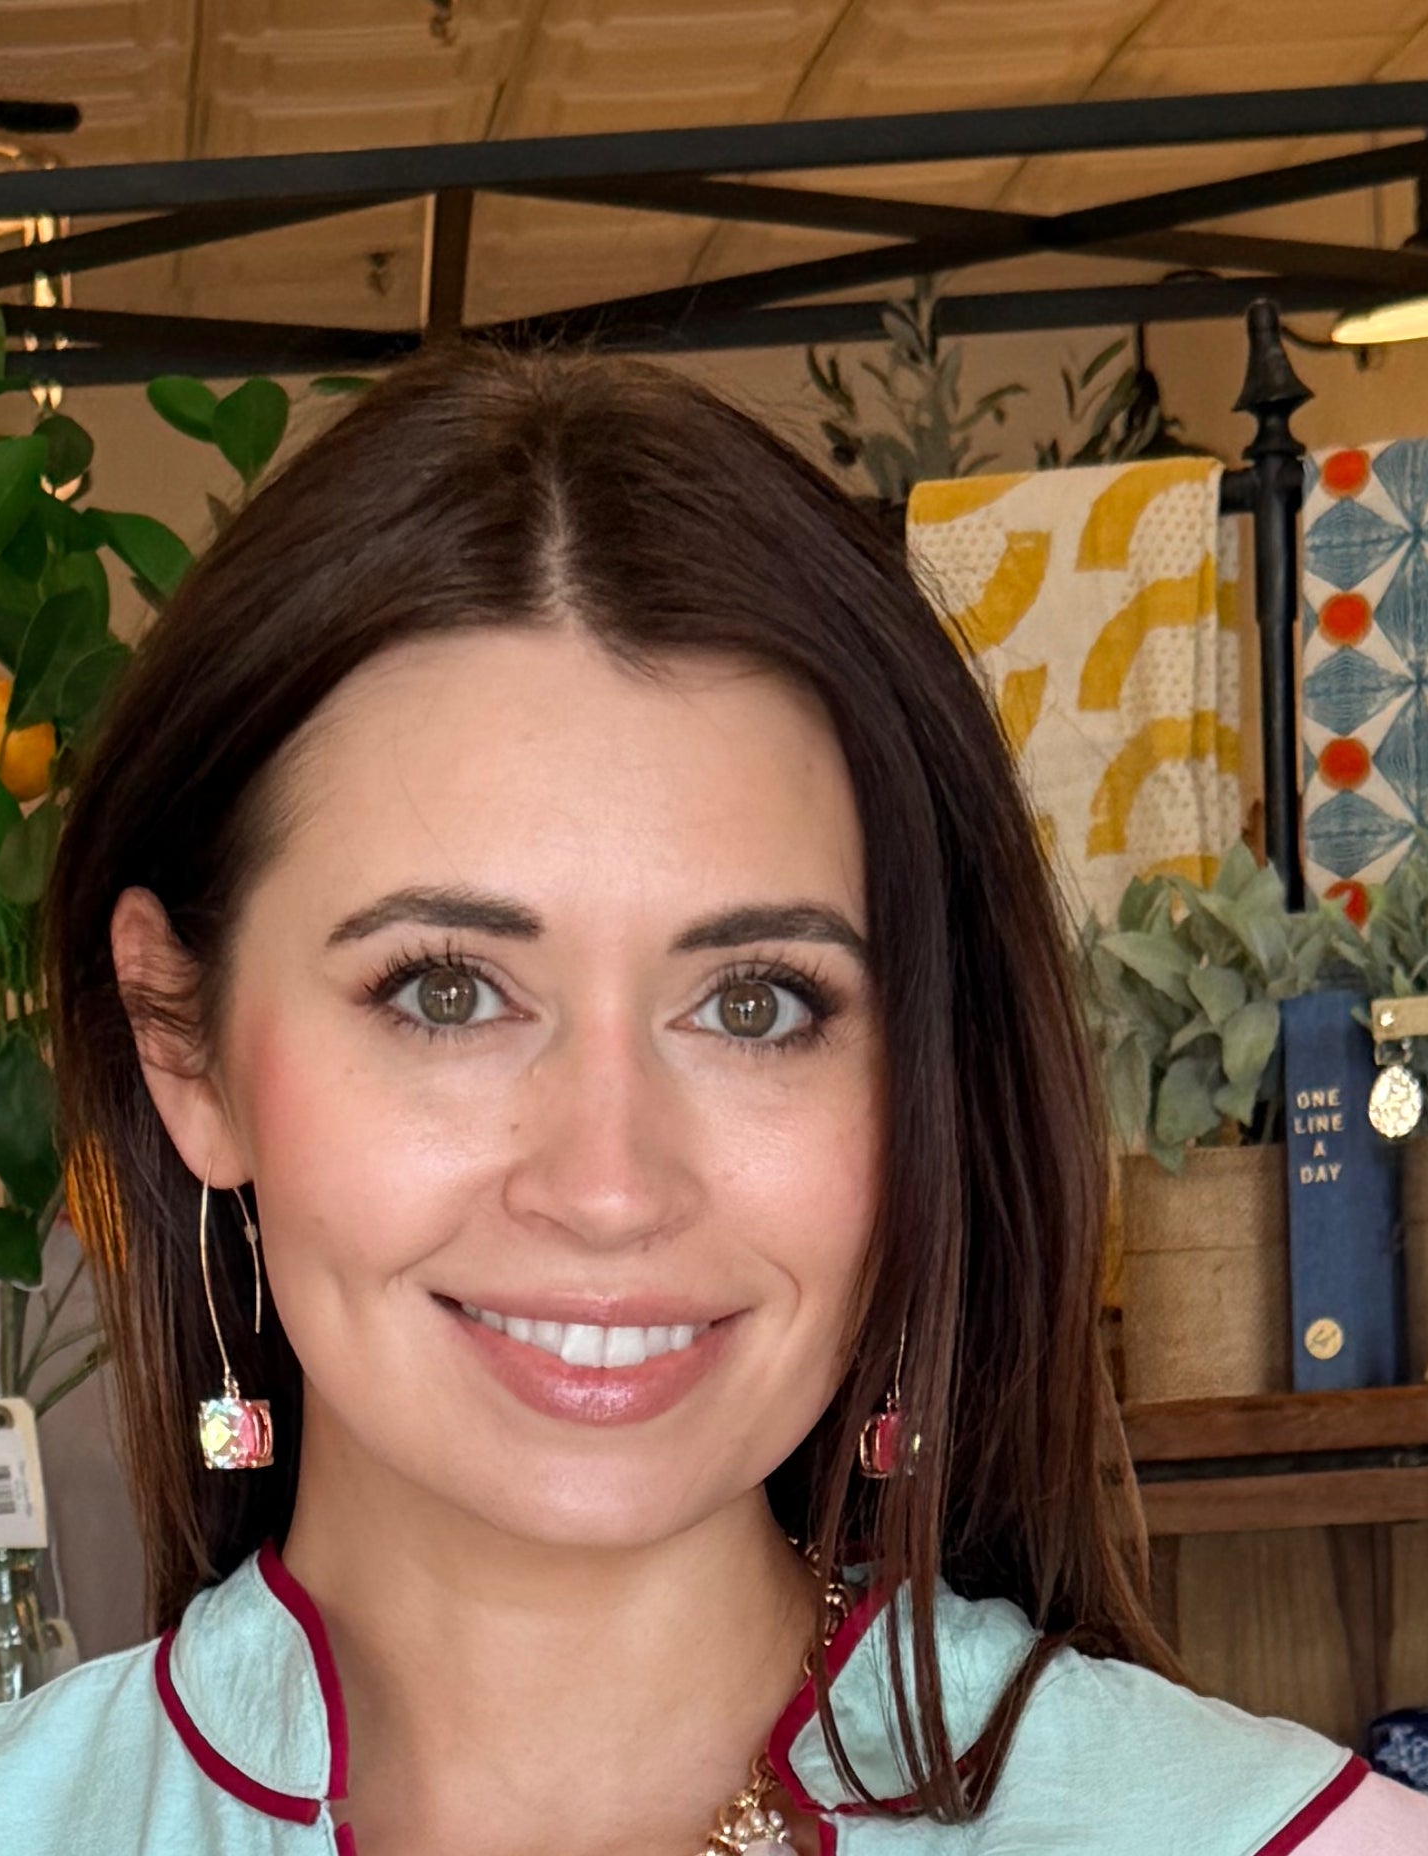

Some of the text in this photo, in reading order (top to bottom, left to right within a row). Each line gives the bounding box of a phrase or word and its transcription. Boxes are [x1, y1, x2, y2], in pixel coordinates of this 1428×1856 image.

[1296, 1088, 1341, 1110] ONE
[1294, 1113, 1344, 1135] LINE
[1313, 1140, 1327, 1157] A
[1299, 1163, 1342, 1185] DAY
